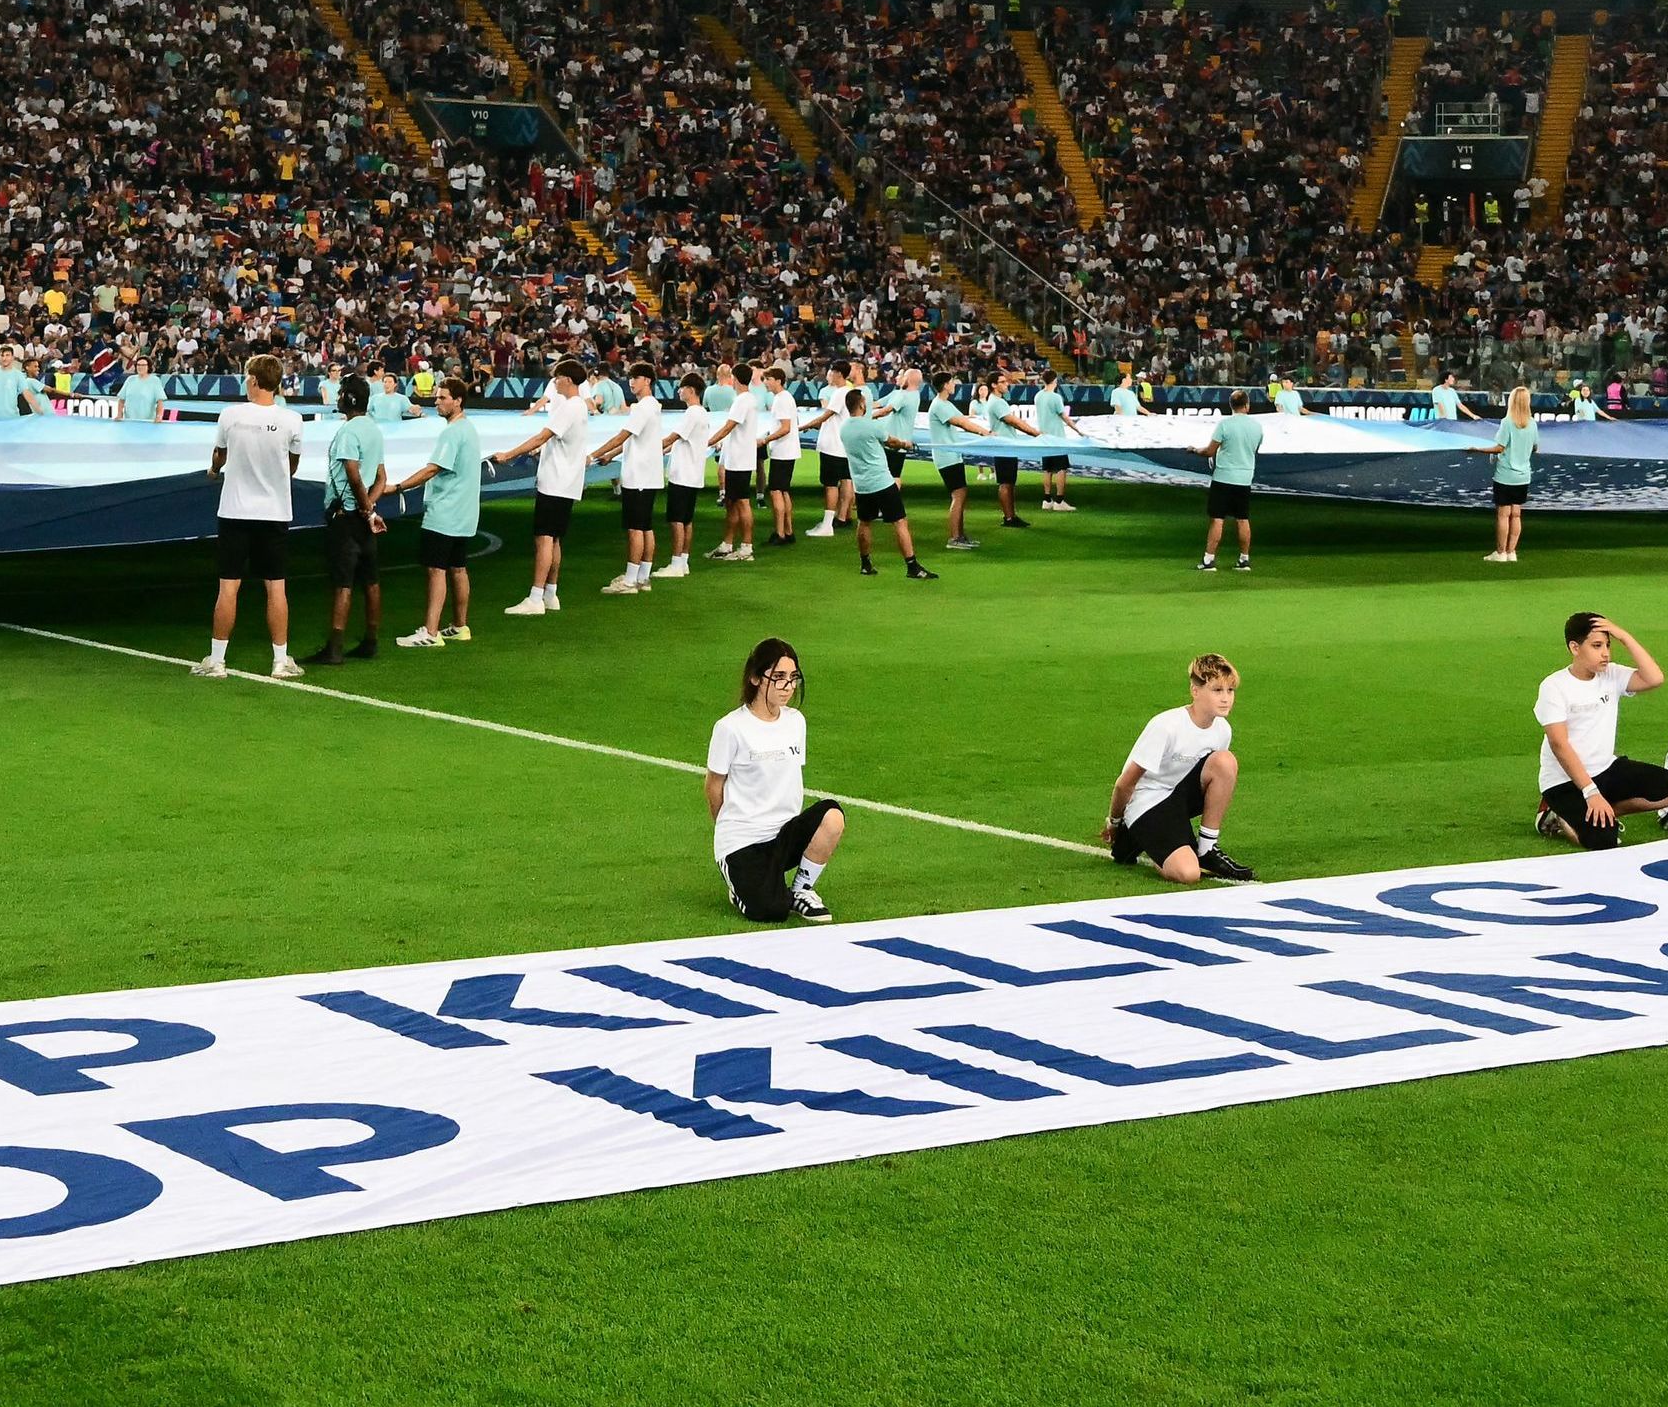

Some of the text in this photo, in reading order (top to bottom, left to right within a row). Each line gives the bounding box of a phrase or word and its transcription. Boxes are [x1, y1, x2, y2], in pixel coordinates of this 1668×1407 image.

[470, 110, 489, 120] V10
[1456, 145, 1473, 154] V11
[300, 881, 1660, 1049] KILLING
